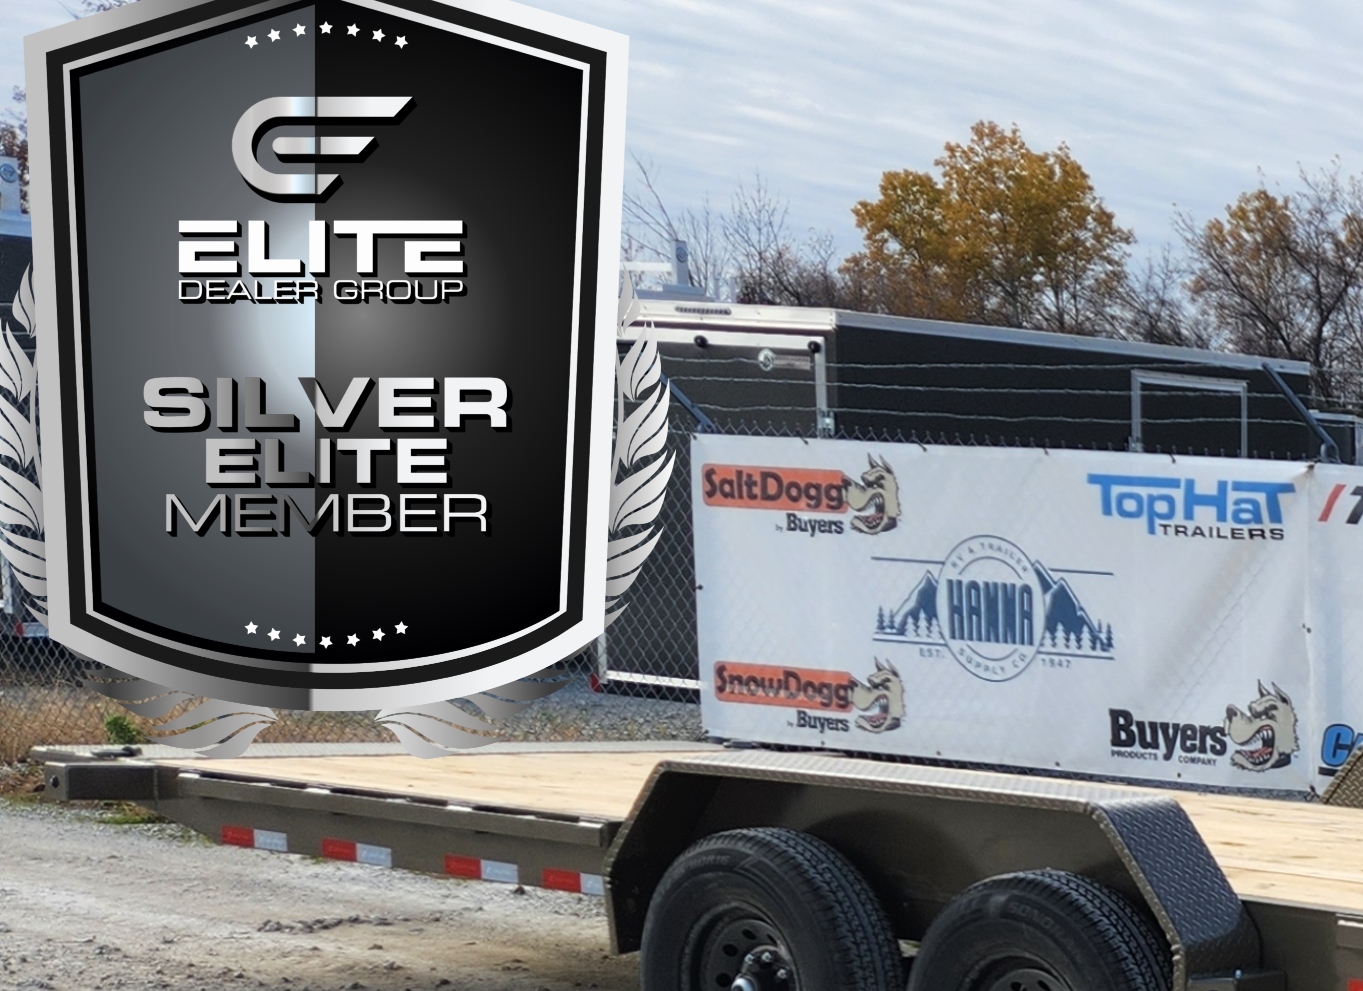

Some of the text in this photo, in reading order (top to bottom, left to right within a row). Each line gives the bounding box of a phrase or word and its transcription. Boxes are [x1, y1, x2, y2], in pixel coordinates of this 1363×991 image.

[704, 467, 846, 510] SaltDogg
[786, 512, 844, 537] Buyers
[1158, 523, 1285, 541] TRAILERS
[980, 541, 1029, 573] TRAILER
[946, 578, 1034, 646] HANNA
[957, 647, 1006, 676] SUPPLY
[715, 664, 852, 709] SnowDogg
[796, 710, 849, 734] Buyers
[1108, 708, 1228, 762] Buyers
[1110, 749, 1218, 767] PRODUCTS COMPANY
